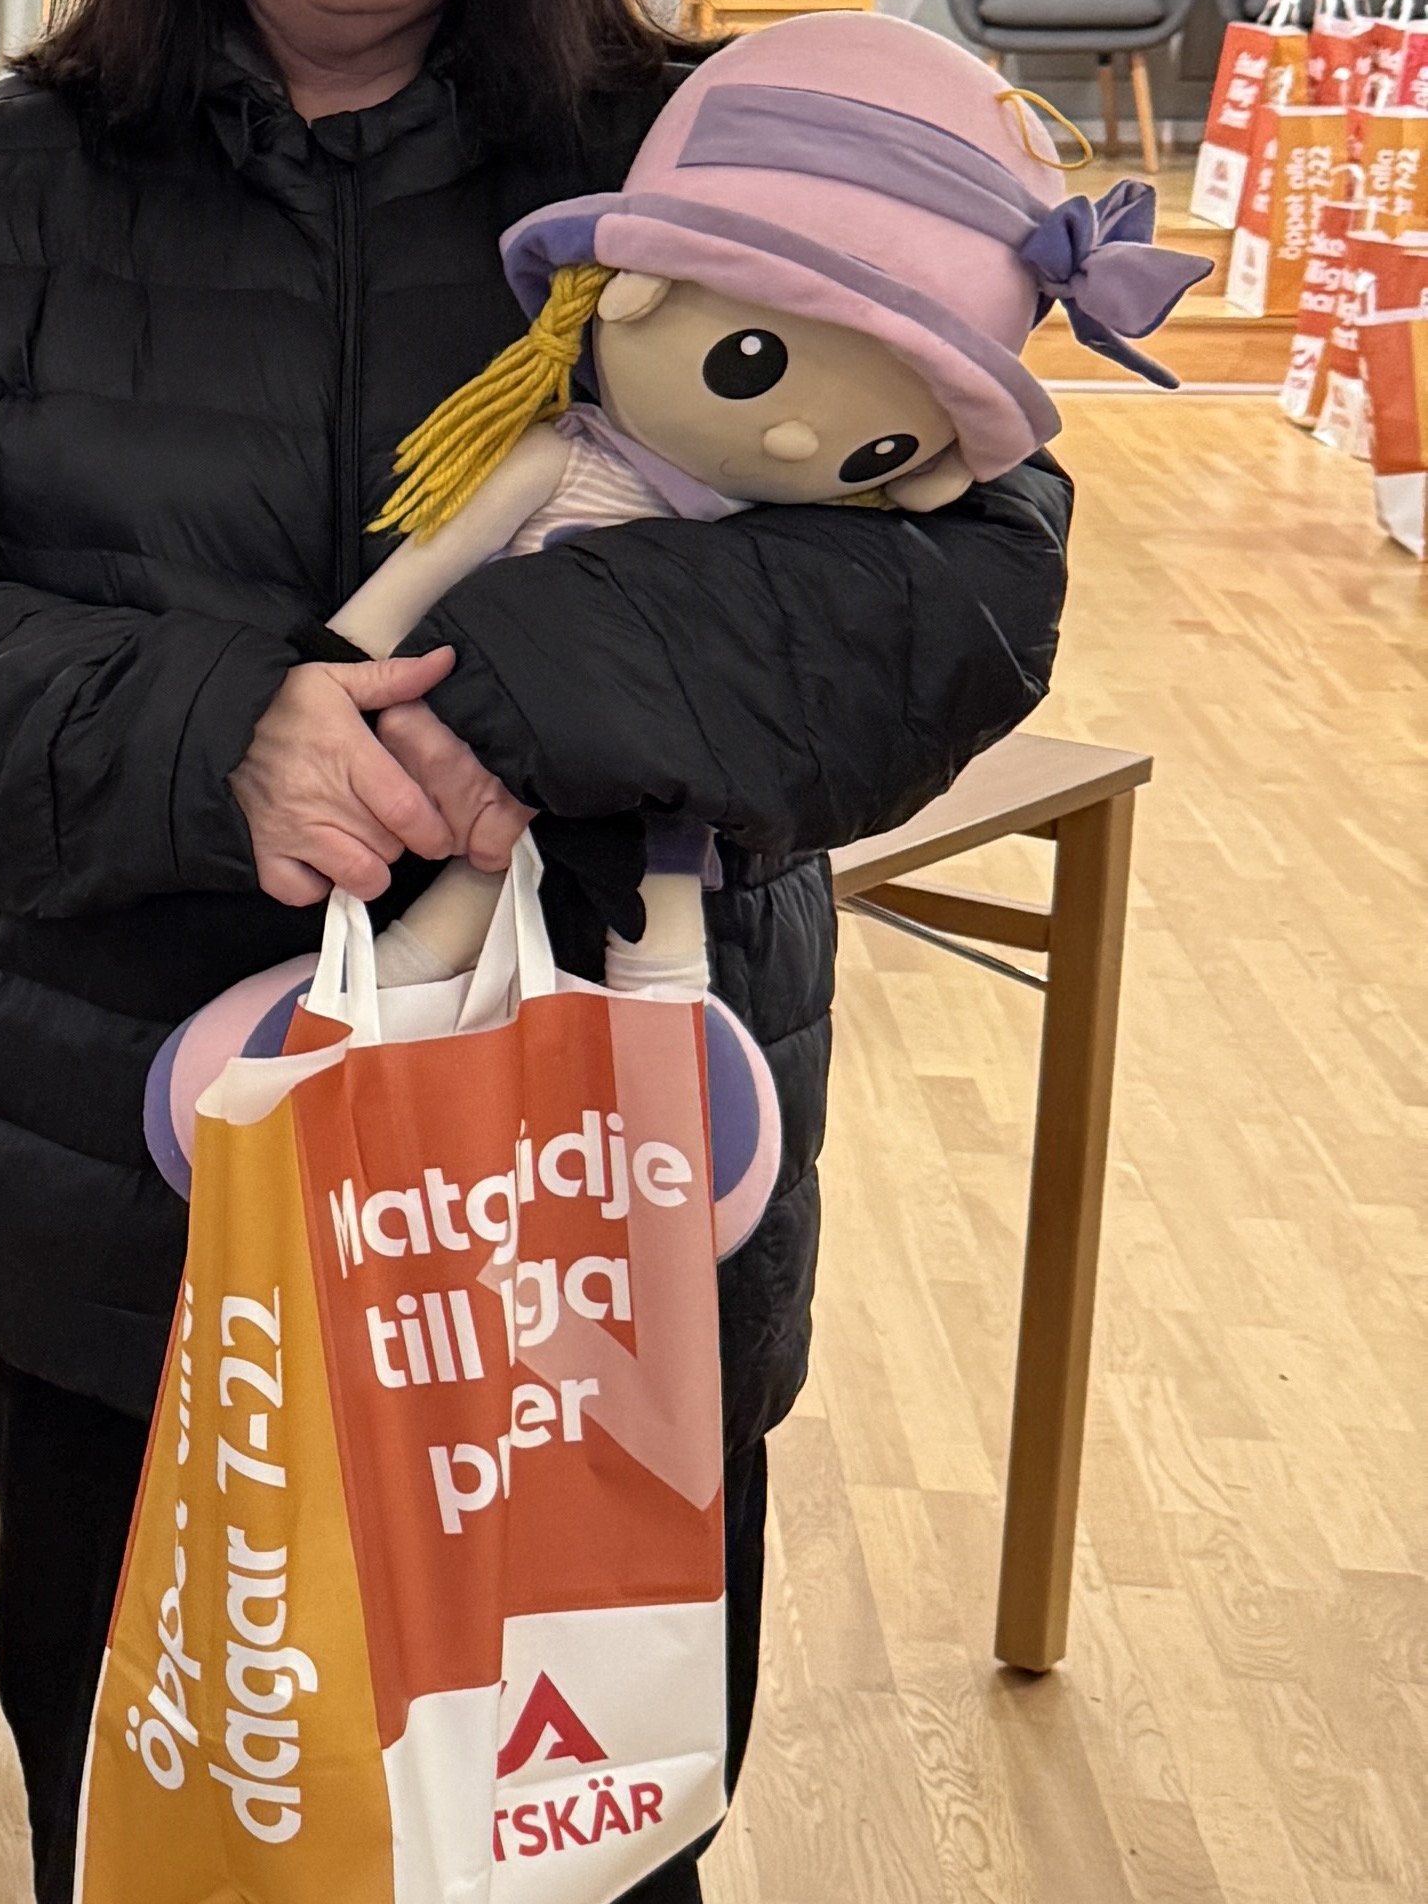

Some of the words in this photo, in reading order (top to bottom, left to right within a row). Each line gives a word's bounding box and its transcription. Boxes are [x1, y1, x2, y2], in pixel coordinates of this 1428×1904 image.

[216, 1286, 287, 1494] 7-22
[365, 1289, 484, 1388] till
[209, 1525, 319, 1845] dagar
